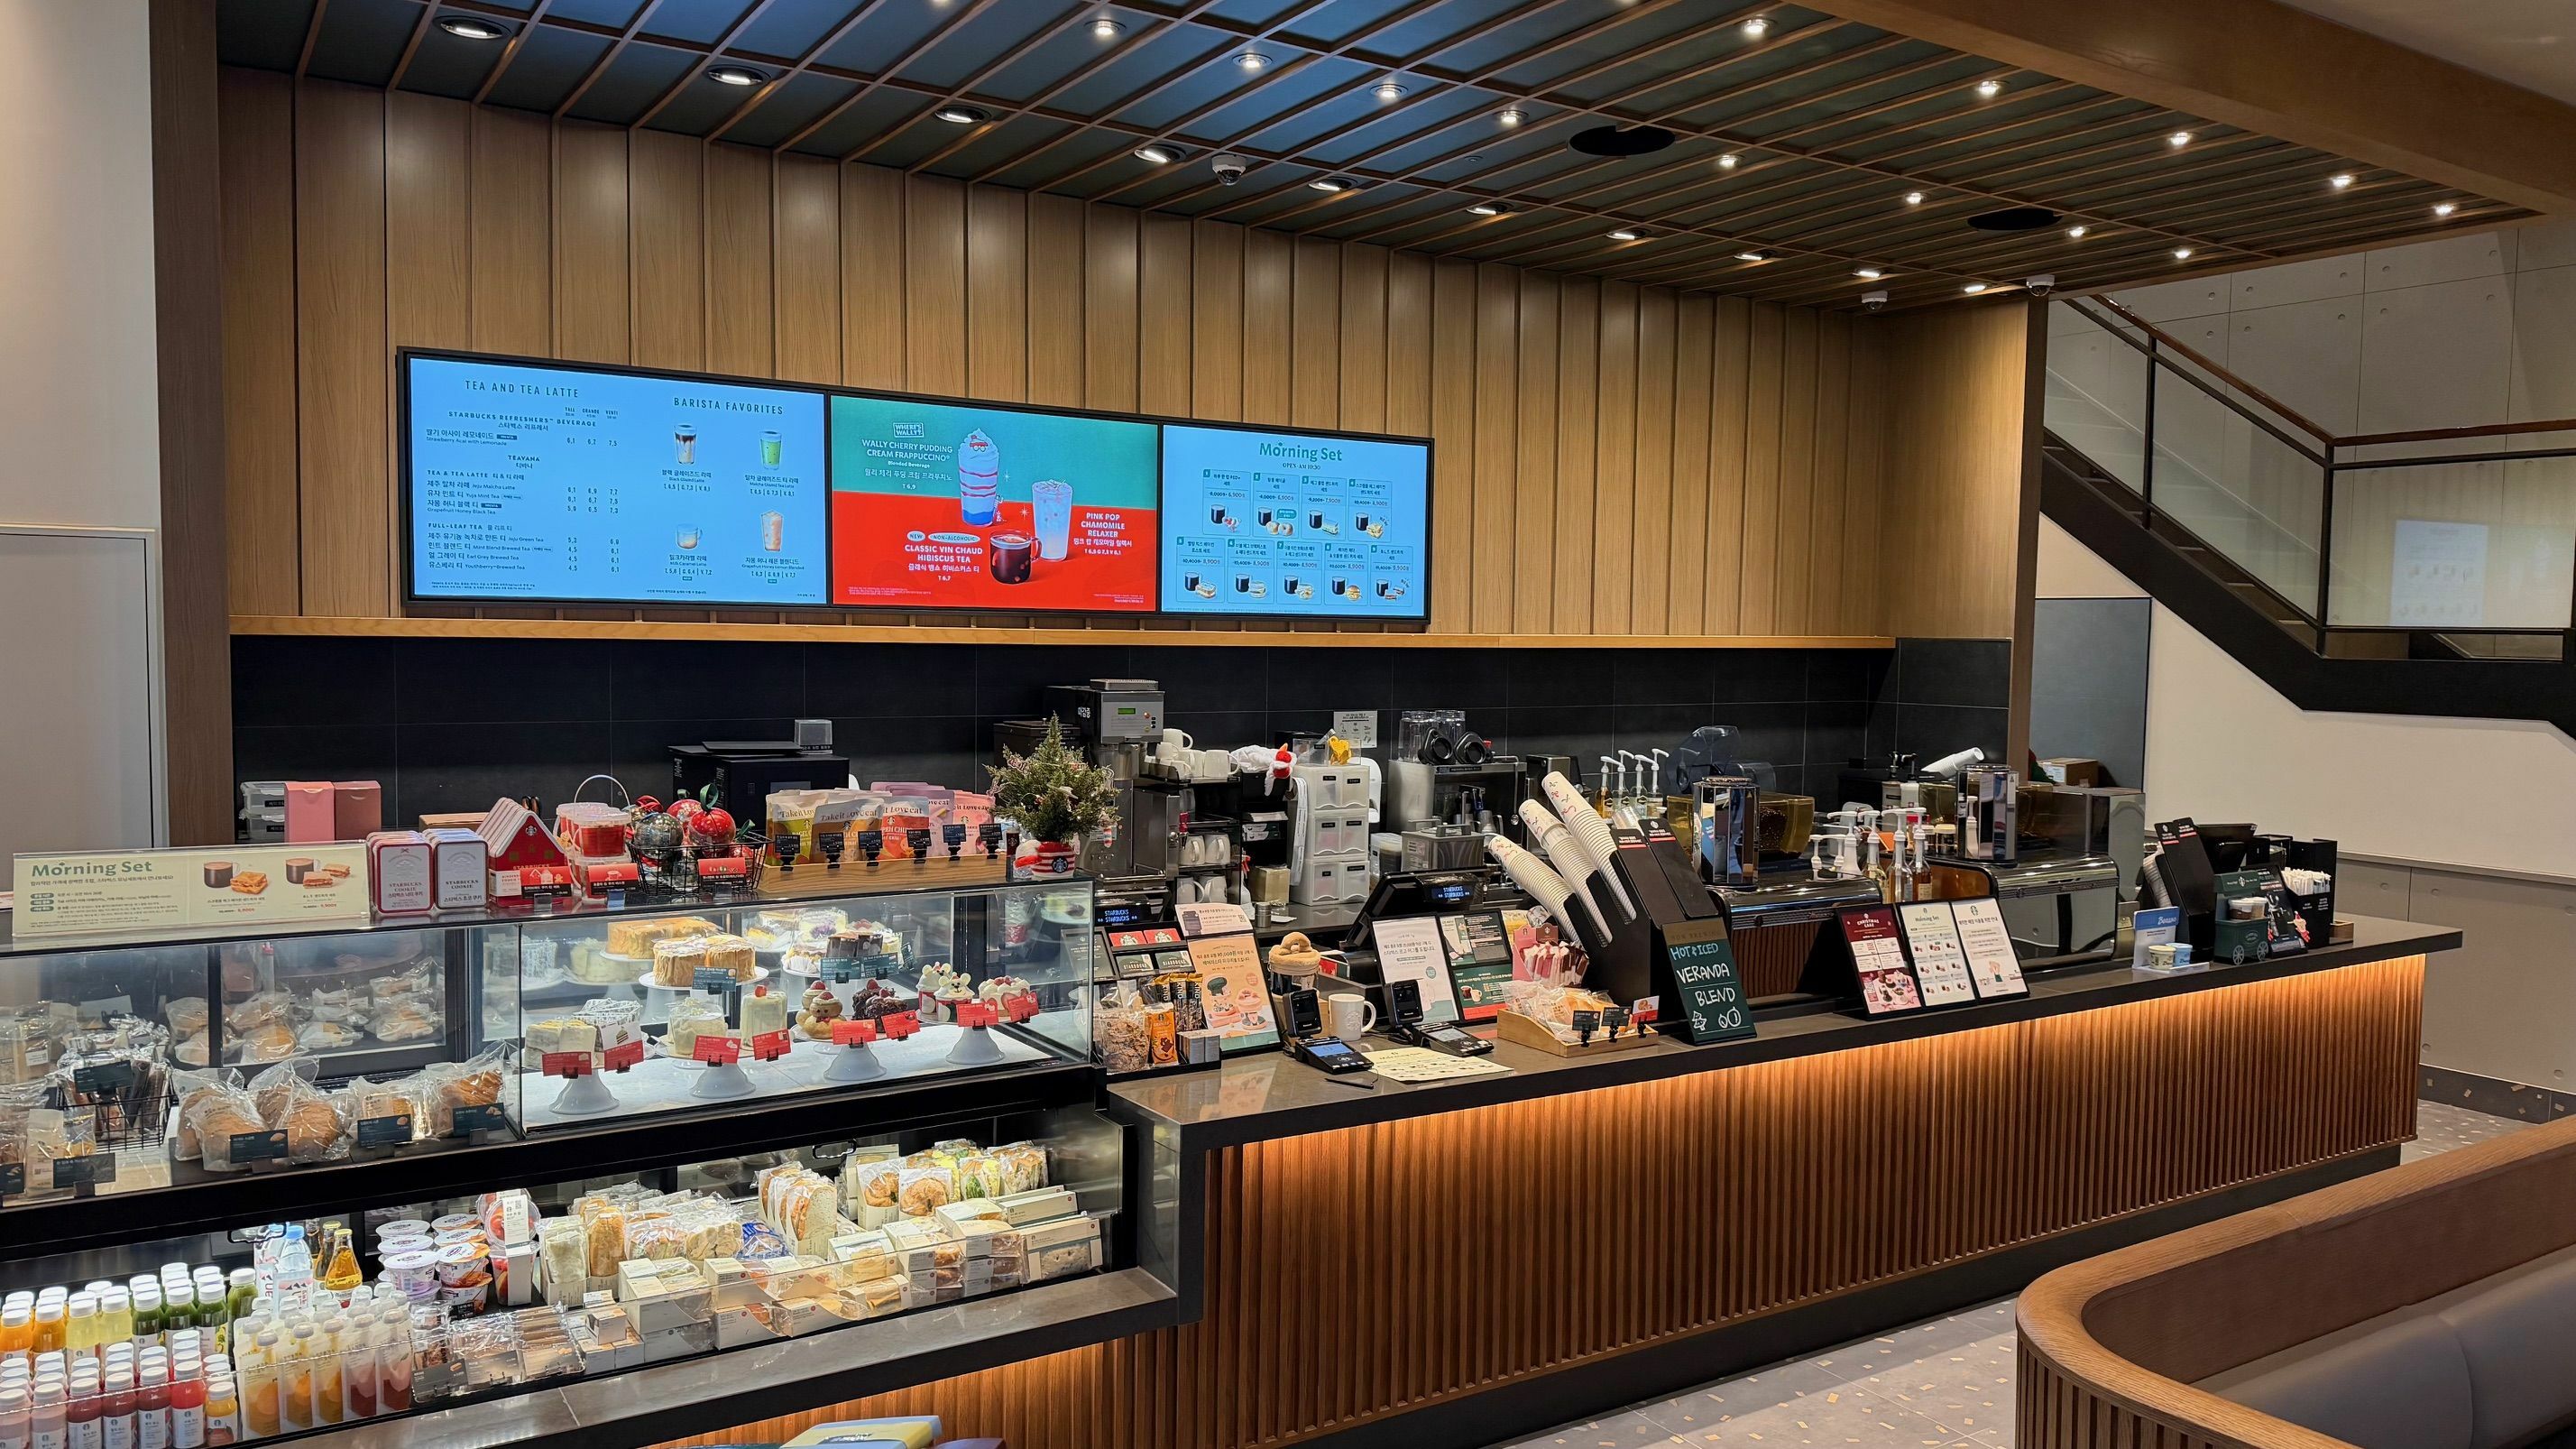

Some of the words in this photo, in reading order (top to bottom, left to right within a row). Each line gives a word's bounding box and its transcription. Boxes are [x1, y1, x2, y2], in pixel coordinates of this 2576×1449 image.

[465, 380, 485, 391] TEA
[492, 383, 514, 393] AND
[520, 384, 540, 395] TEA
[546, 386, 578, 398] LATTE
[674, 397, 721, 410] BARISTA
[726, 401, 783, 415] FAVORITES
[448, 411, 496, 420] STARBUCKS
[557, 419, 596, 427] BEVERAGE
[498, 421, 523, 429] 스타벅스
[862, 439, 888, 448] WALLY
[889, 441, 918, 450] CHERRY
[919, 444, 953, 453] PUDDING
[867, 448, 894, 458] CREAM
[1259, 442, 1318, 462] Morning
[1320, 448, 1342, 461] Set
[1086, 512, 1104, 520] PINK
[1081, 521, 1126, 530] CHAMOMILE
[1088, 530, 1118, 538] RELAXER
[904, 544, 937, 552] CLASSIC
[955, 547, 983, 555] CHAUD
[917, 554, 954, 562] HIBISCUS
[780, 809, 797, 818] Take
[821, 811, 840, 821] Take
[32, 860, 116, 877] Morning
[121, 861, 152, 873] Set
[1104, 909, 1129, 917] STARBUCKS
[1676, 963, 1730, 984] VERANDA
[1694, 987, 1736, 1007] BLEND
